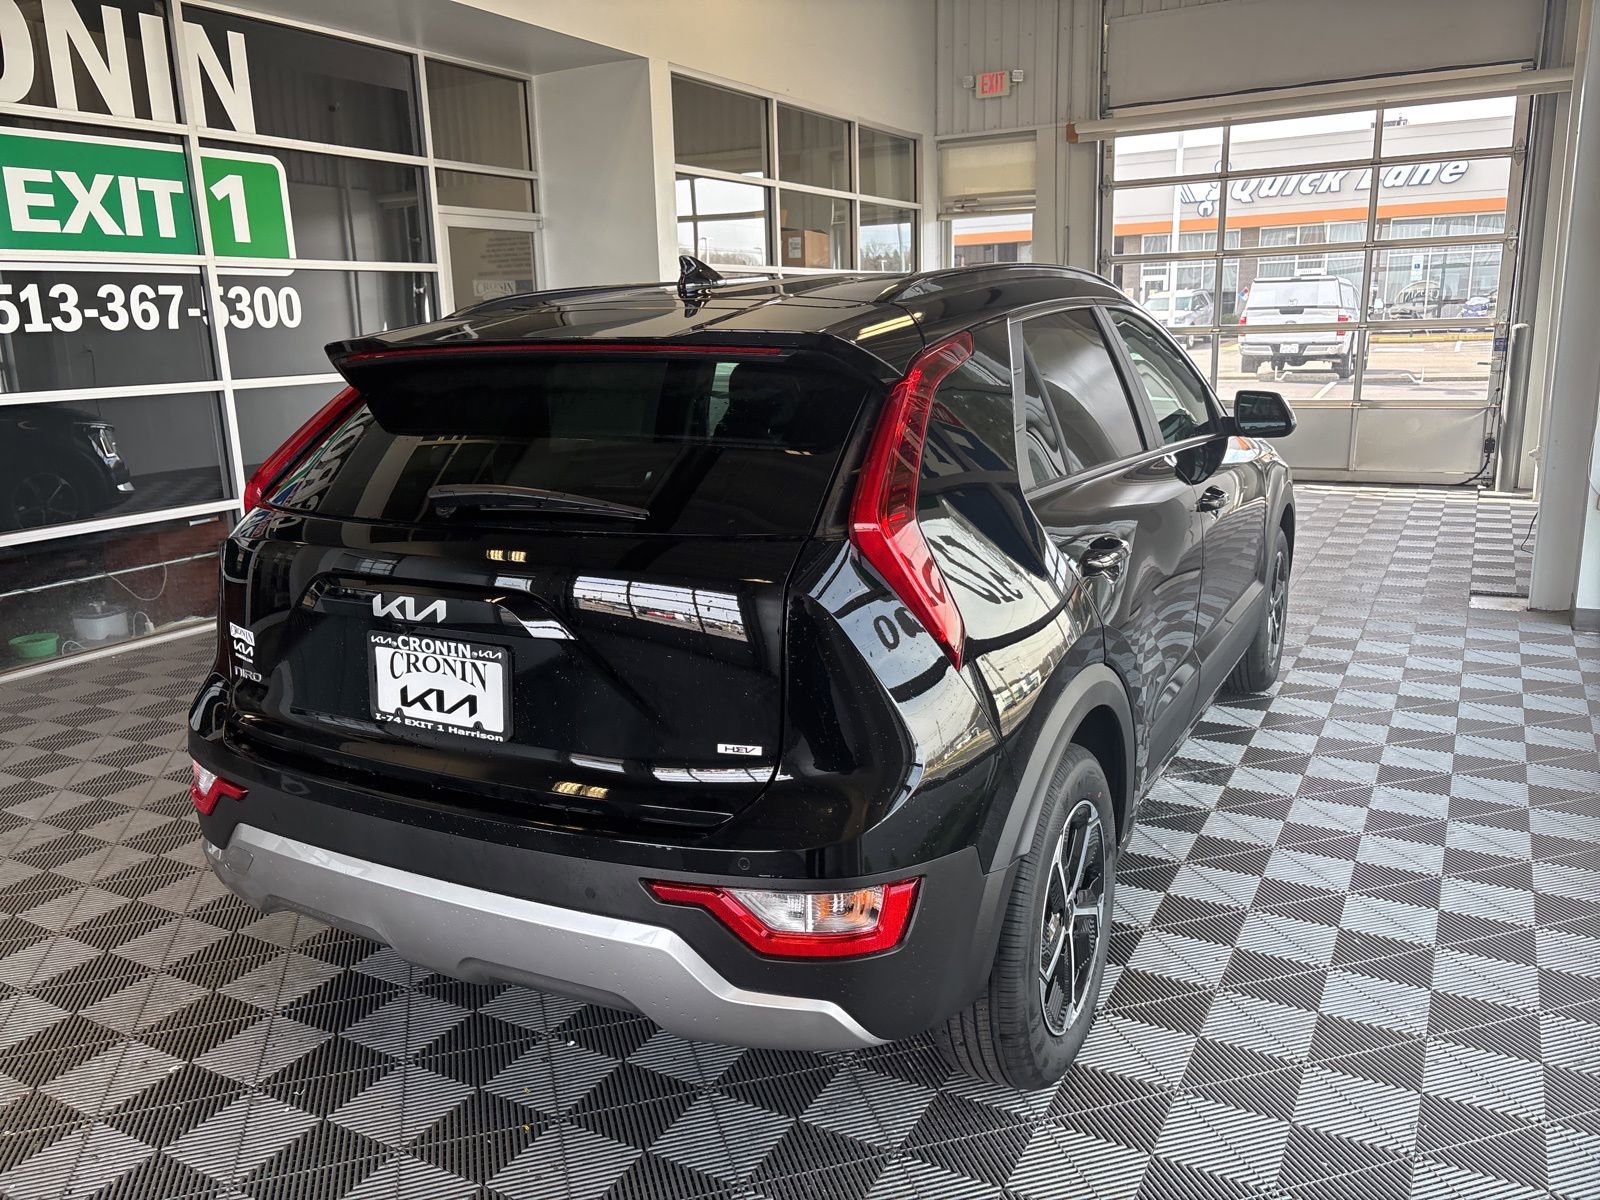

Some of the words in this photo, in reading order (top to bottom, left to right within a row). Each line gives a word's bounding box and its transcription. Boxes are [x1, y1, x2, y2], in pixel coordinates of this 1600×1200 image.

[981, 72, 1005, 95] EXIT
[1231, 169, 1350, 203] Quick
[2, 166, 184, 238] EXIT
[209, 174, 251, 243] 1
[398, 636, 471, 658] CRONIN
[389, 651, 488, 693] CRONIN
[375, 713, 402, 724] I-74
[404, 718, 434, 730] EXIT
[437, 724, 446, 732] 1
[448, 726, 503, 743] Harrison
[724, 745, 756, 754] HEV
